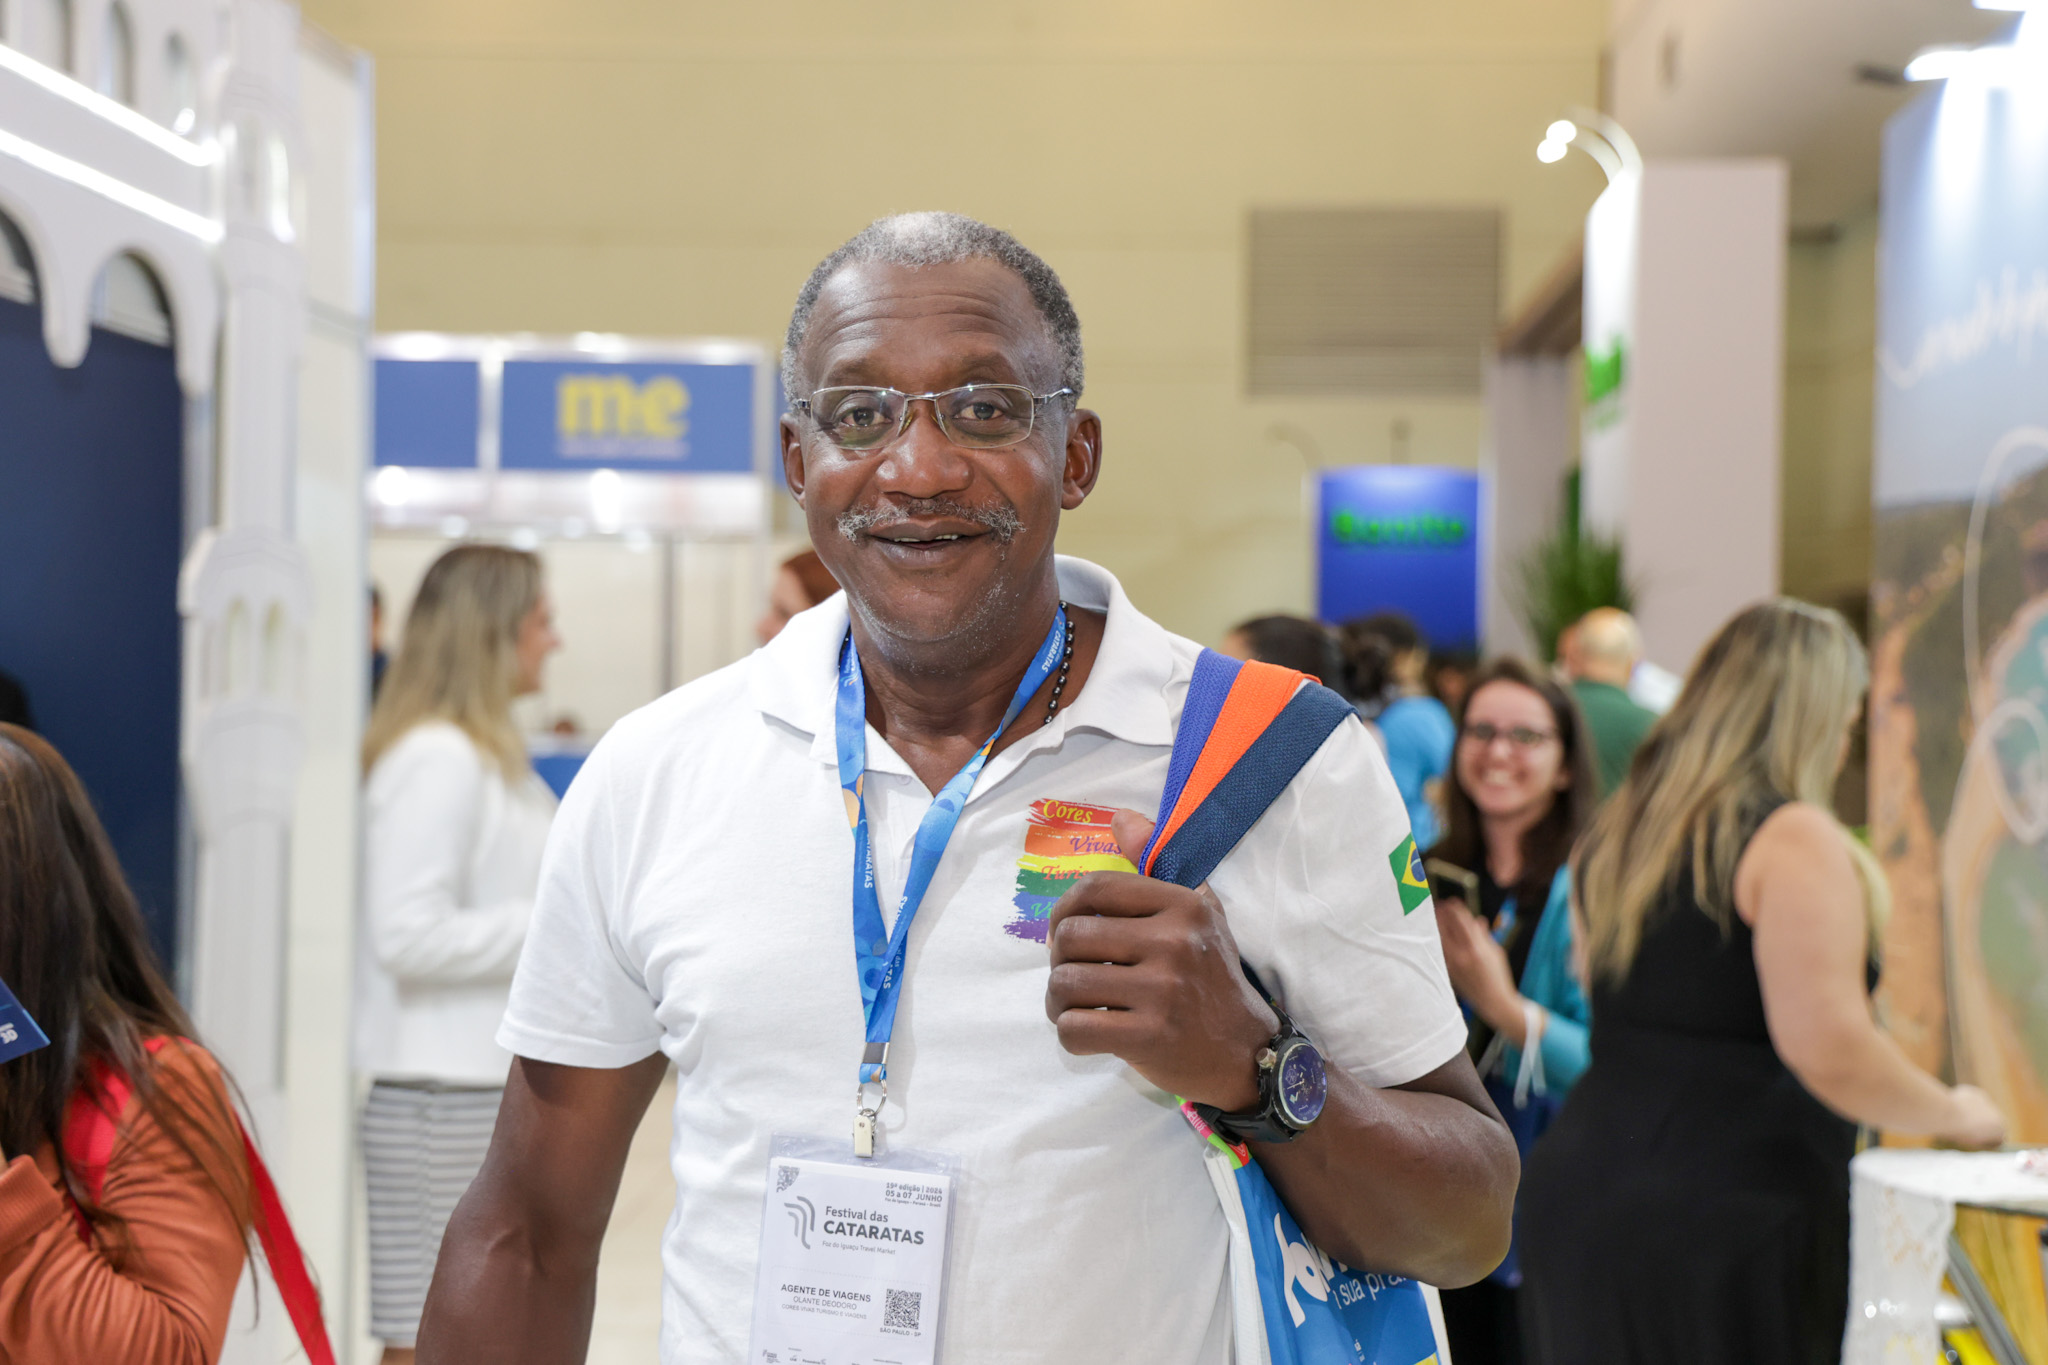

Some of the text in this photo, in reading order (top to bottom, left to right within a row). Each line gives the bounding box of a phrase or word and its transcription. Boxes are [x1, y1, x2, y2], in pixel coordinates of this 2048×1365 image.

[1041, 630, 1062, 673] CATARATAS
[1043, 800, 1093, 823] Cores
[1070, 836, 1122, 855] Vivas
[885, 1189, 895, 1197] 05
[902, 1191, 913, 1199] 07
[915, 1193, 943, 1203] JUNHO
[825, 1205, 889, 1223] Festival das
[823, 1220, 925, 1245] CATARATAS
[822, 1240, 832, 1248] Foz
[832, 1241, 840, 1249] do
[859, 1244, 876, 1253] Travel
[876, 1247, 896, 1255] Market
[780, 1283, 872, 1303] AGENTE DE VIAGENS
[1339, 1278, 1366, 1306] sua
[781, 1303, 800, 1311] CORES
[816, 1307, 840, 1316] TURISMO
[844, 1311, 867, 1320] VIAGENS
[821, 1299, 857, 1311] DEODORO
[879, 1326, 891, 1334] SÃO
[891, 1328, 910, 1336] PAULO
